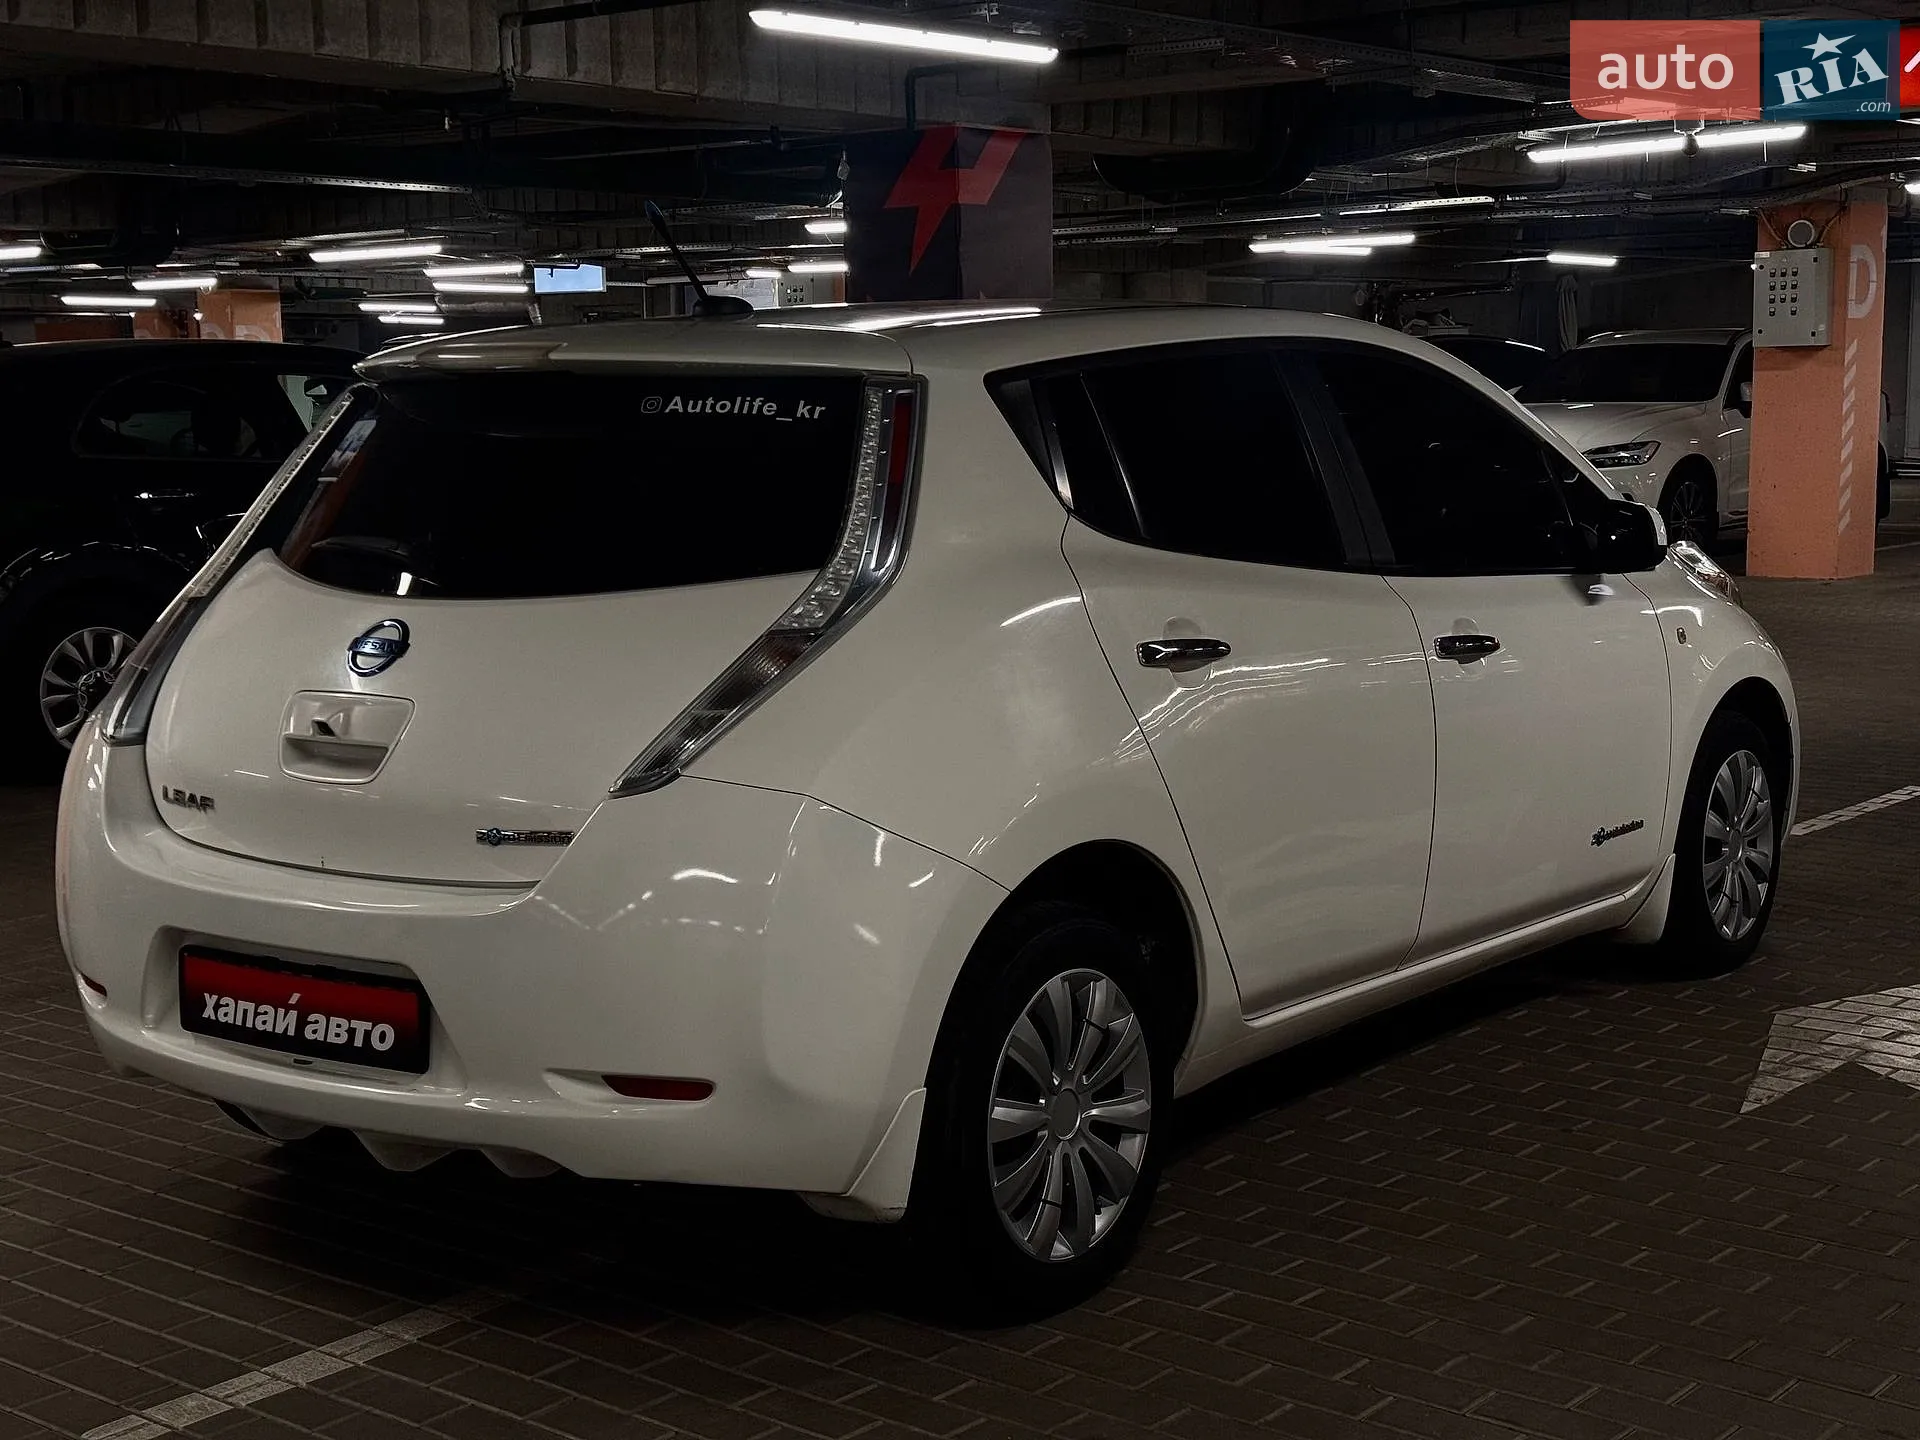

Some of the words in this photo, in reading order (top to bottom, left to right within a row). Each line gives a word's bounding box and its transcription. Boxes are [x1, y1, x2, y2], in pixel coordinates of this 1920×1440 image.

[1847, 244, 1878, 319] D
[664, 395, 827, 422] Autolife_kr
[162, 784, 216, 814] LEAF
[304, 1012, 396, 1052] авто
